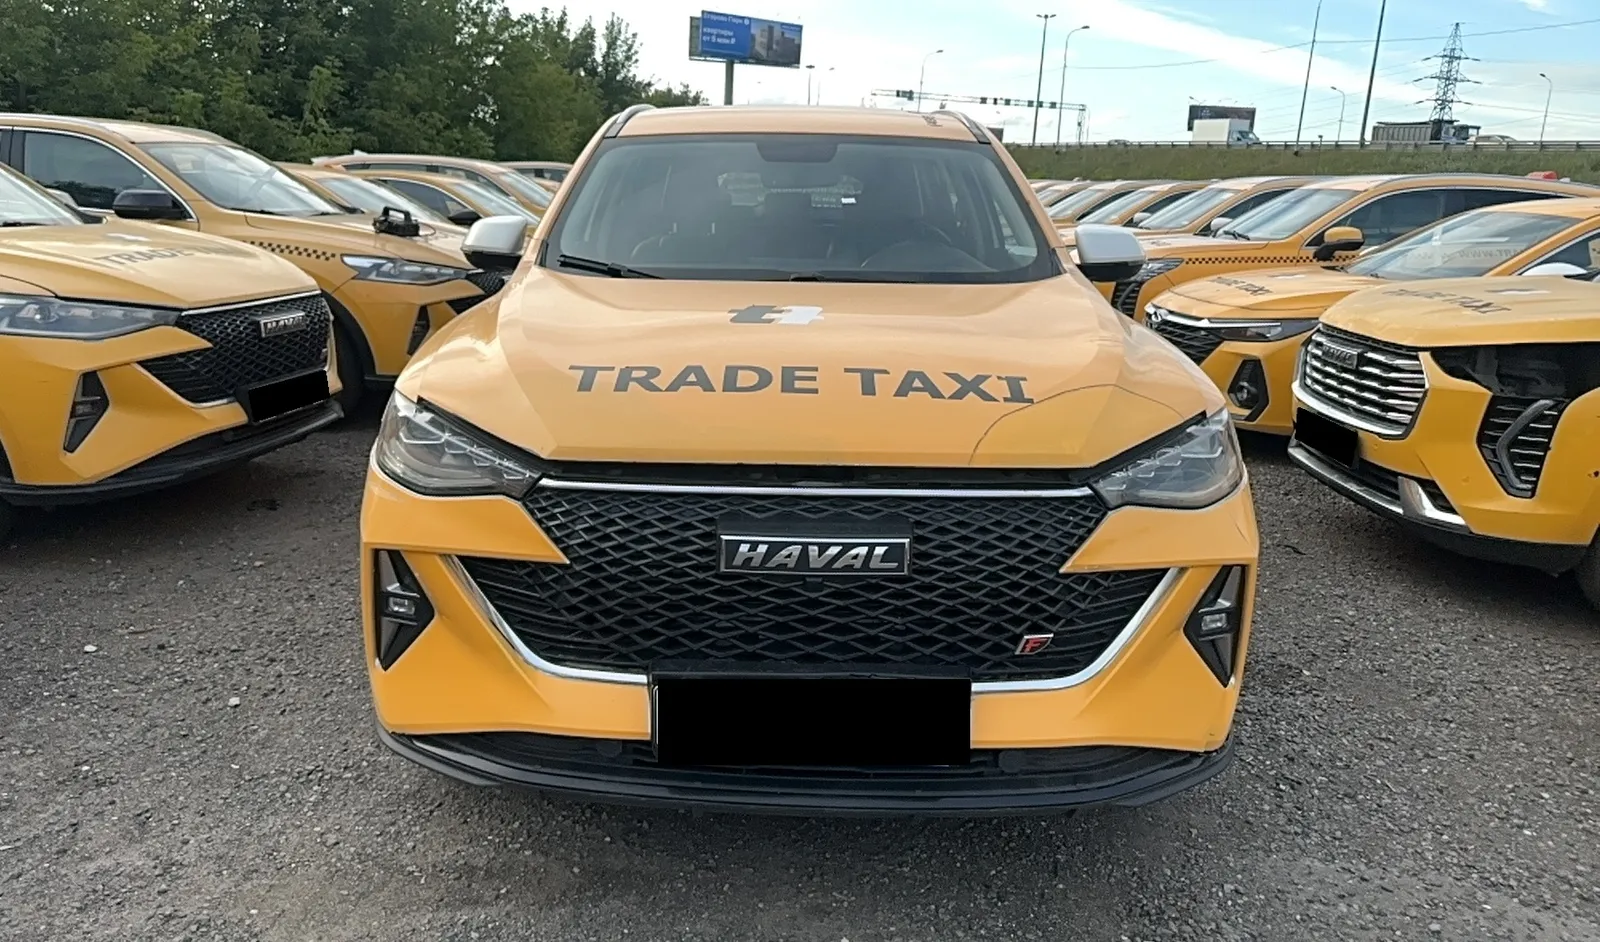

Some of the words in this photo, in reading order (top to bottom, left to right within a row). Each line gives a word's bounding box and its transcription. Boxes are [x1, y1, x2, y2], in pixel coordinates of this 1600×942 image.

[568, 364, 819, 395] TRADE
[843, 367, 1035, 404] TAXI
[731, 543, 899, 570] HAVAL
